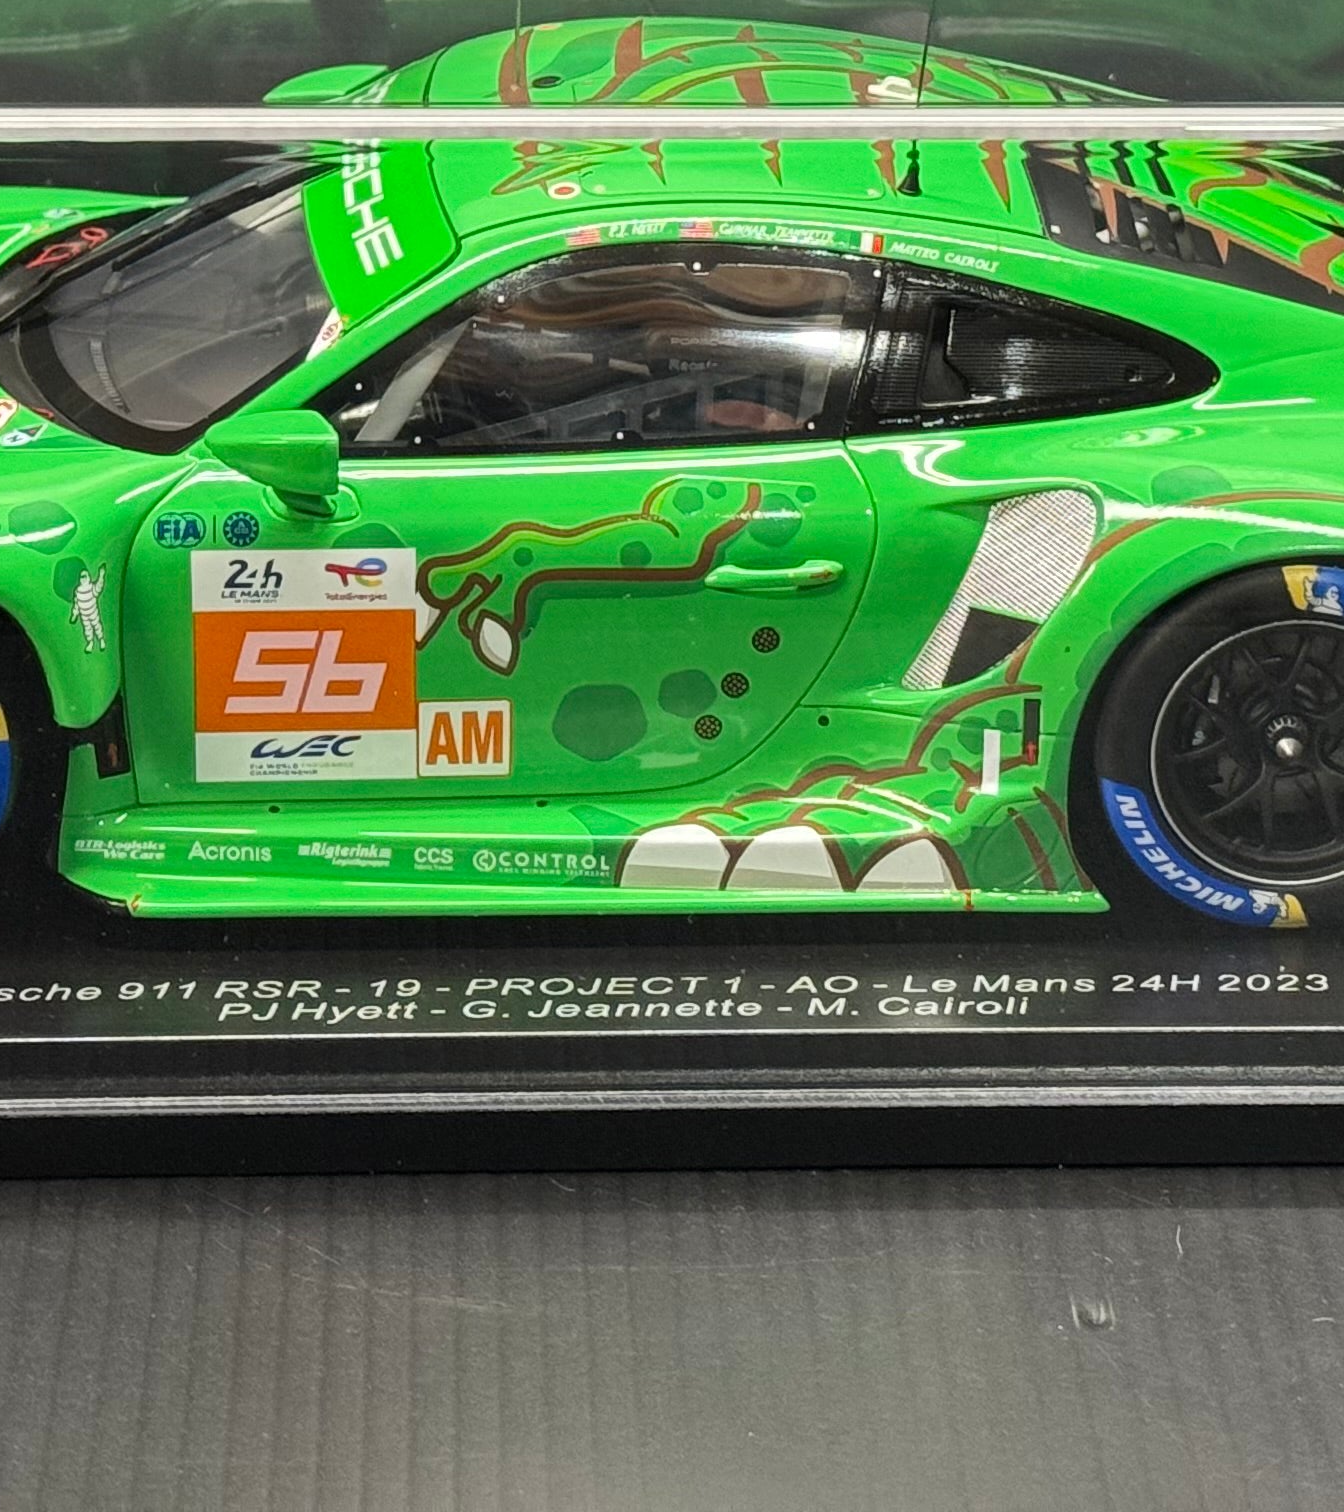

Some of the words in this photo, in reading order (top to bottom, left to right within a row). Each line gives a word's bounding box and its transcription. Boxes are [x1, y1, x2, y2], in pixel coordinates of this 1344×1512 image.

[889, 241, 940, 260] MATTEO
[221, 590, 237, 599] LE
[240, 590, 279, 599] MANS
[224, 630, 388, 714] 56
[425, 710, 504, 765] AM
[187, 840, 273, 863] Acronis
[310, 841, 379, 860] Rigterink
[413, 846, 455, 865] CCS
[498, 851, 611, 871] CONTROL
[1115, 794, 1246, 914] MICHELIN
[118, 980, 197, 1001] 911
[213, 980, 322, 999] RSR
[370, 978, 422, 998] 19
[465, 976, 708, 996] PROJECT
[724, 975, 742, 994] 1
[786, 975, 859, 994] AO
[903, 974, 958, 994] Le
[972, 974, 1096, 994] Mans
[1112, 973, 1201, 992] 24H
[1218, 973, 1329, 992] 2023
[218, 1002, 279, 1022] PJ
[292, 1001, 419, 1024] Hyett
[462, 999, 510, 1019] G.
[527, 998, 763, 1019] Jeannette
[807, 997, 860, 1017] M.
[878, 996, 1029, 1016] Cairoli
